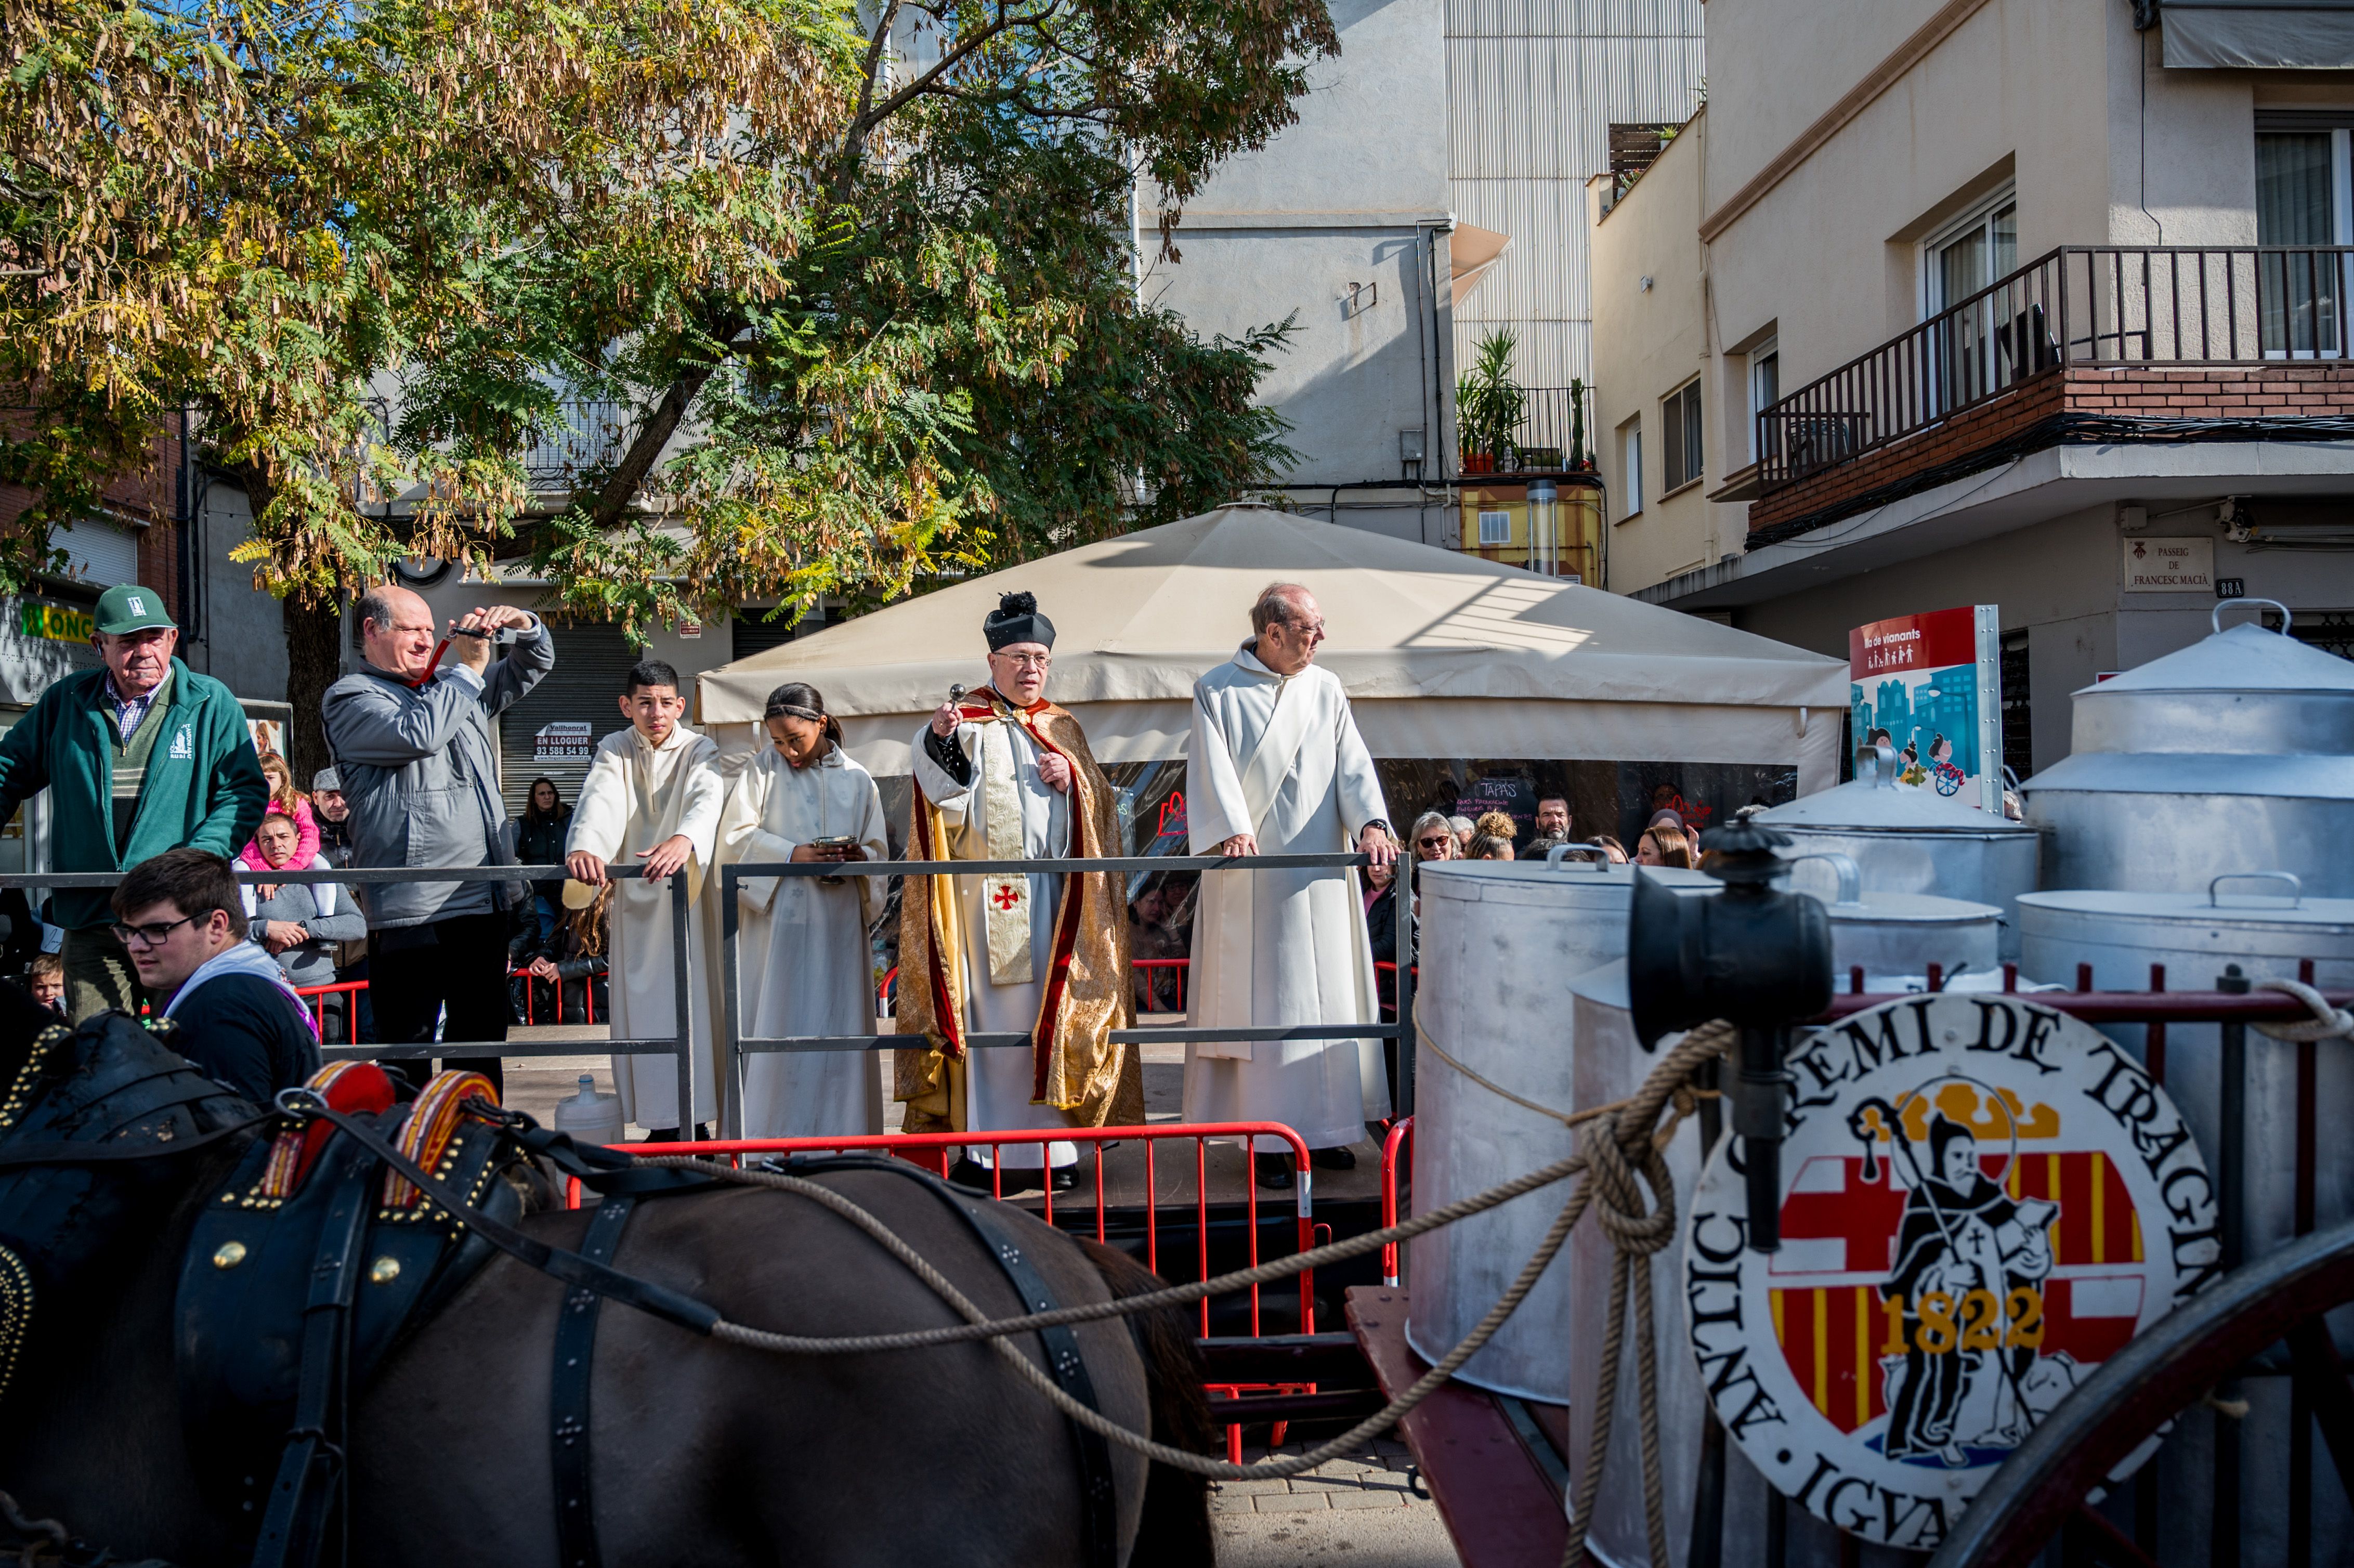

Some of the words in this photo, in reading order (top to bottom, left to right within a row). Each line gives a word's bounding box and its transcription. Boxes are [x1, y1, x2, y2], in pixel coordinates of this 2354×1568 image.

[2158, 547, 2189, 556] PASSEIG
[2168, 561, 2179, 570] DE
[2134, 576, 2178, 585] FRANCESC
[2180, 573, 2208, 585] MACIÀ
[2221, 581, 2242, 595] 88A
[50, 613, 92, 639] ONC
[1873, 635, 1881, 646] de
[1883, 629, 1920, 644] vianants
[537, 747, 547, 755] 93
[549, 747, 564, 755] 588
[566, 747, 577, 755] 54
[579, 747, 589, 755] 99
[1481, 782, 1516, 797] TAPAS
[1965, 999, 2062, 1076] DE
[2082, 1041, 2224, 1308] TRAGIN
[1688, 1212, 1787, 1441] ANTIC
[1880, 1286, 2045, 1355] 1822
[1794, 1453, 1968, 1548] IGVA
